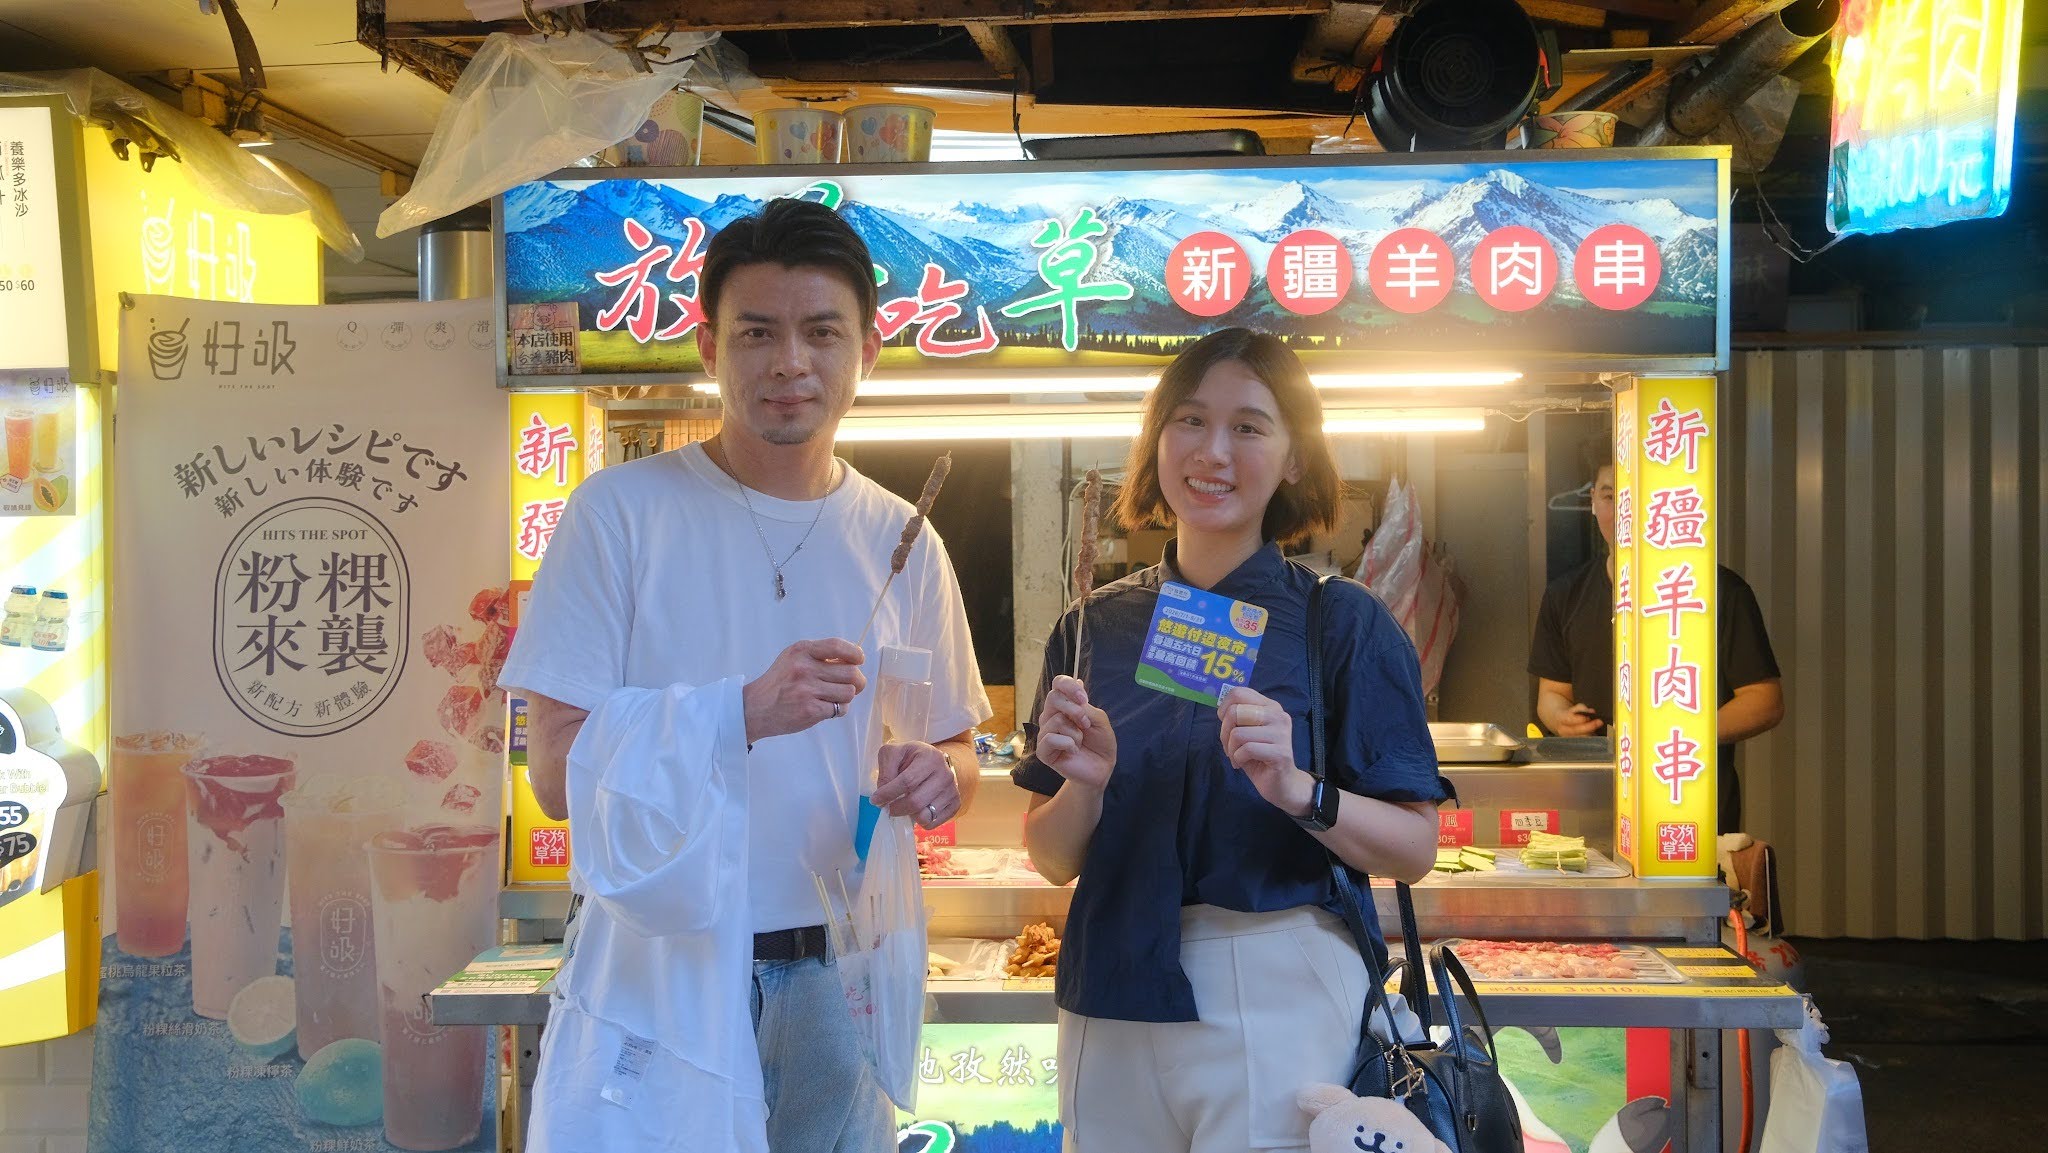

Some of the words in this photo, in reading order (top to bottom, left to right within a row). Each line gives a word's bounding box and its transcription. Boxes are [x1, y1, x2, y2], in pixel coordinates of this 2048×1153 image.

[10, 141, 29, 217] 養樂多冰沙
[595, 180, 1136, 357] 放吃草
[1182, 239, 1646, 301] 新疆羊肉串
[347, 321, 358, 334] Q
[434, 321, 447, 334] 爽
[477, 320, 490, 333] 滑
[517, 331, 573, 348] 本店使用
[173, 424, 468, 499] 新しいレシピです
[214, 458, 419, 519] 新しい体験です
[262, 529, 296, 541] HITS
[299, 529, 328, 540] THE
[332, 529, 368, 540] SPOT
[233, 551, 393, 613] 粉粿
[1643, 401, 1706, 800] 新疆羊肉串
[232, 613, 388, 676] 來襲
[1200, 650, 1245, 684] 15%
[247, 680, 302, 718] 新配方
[314, 680, 372, 718] 新體驗
[924, 835, 949, 845] $30元
